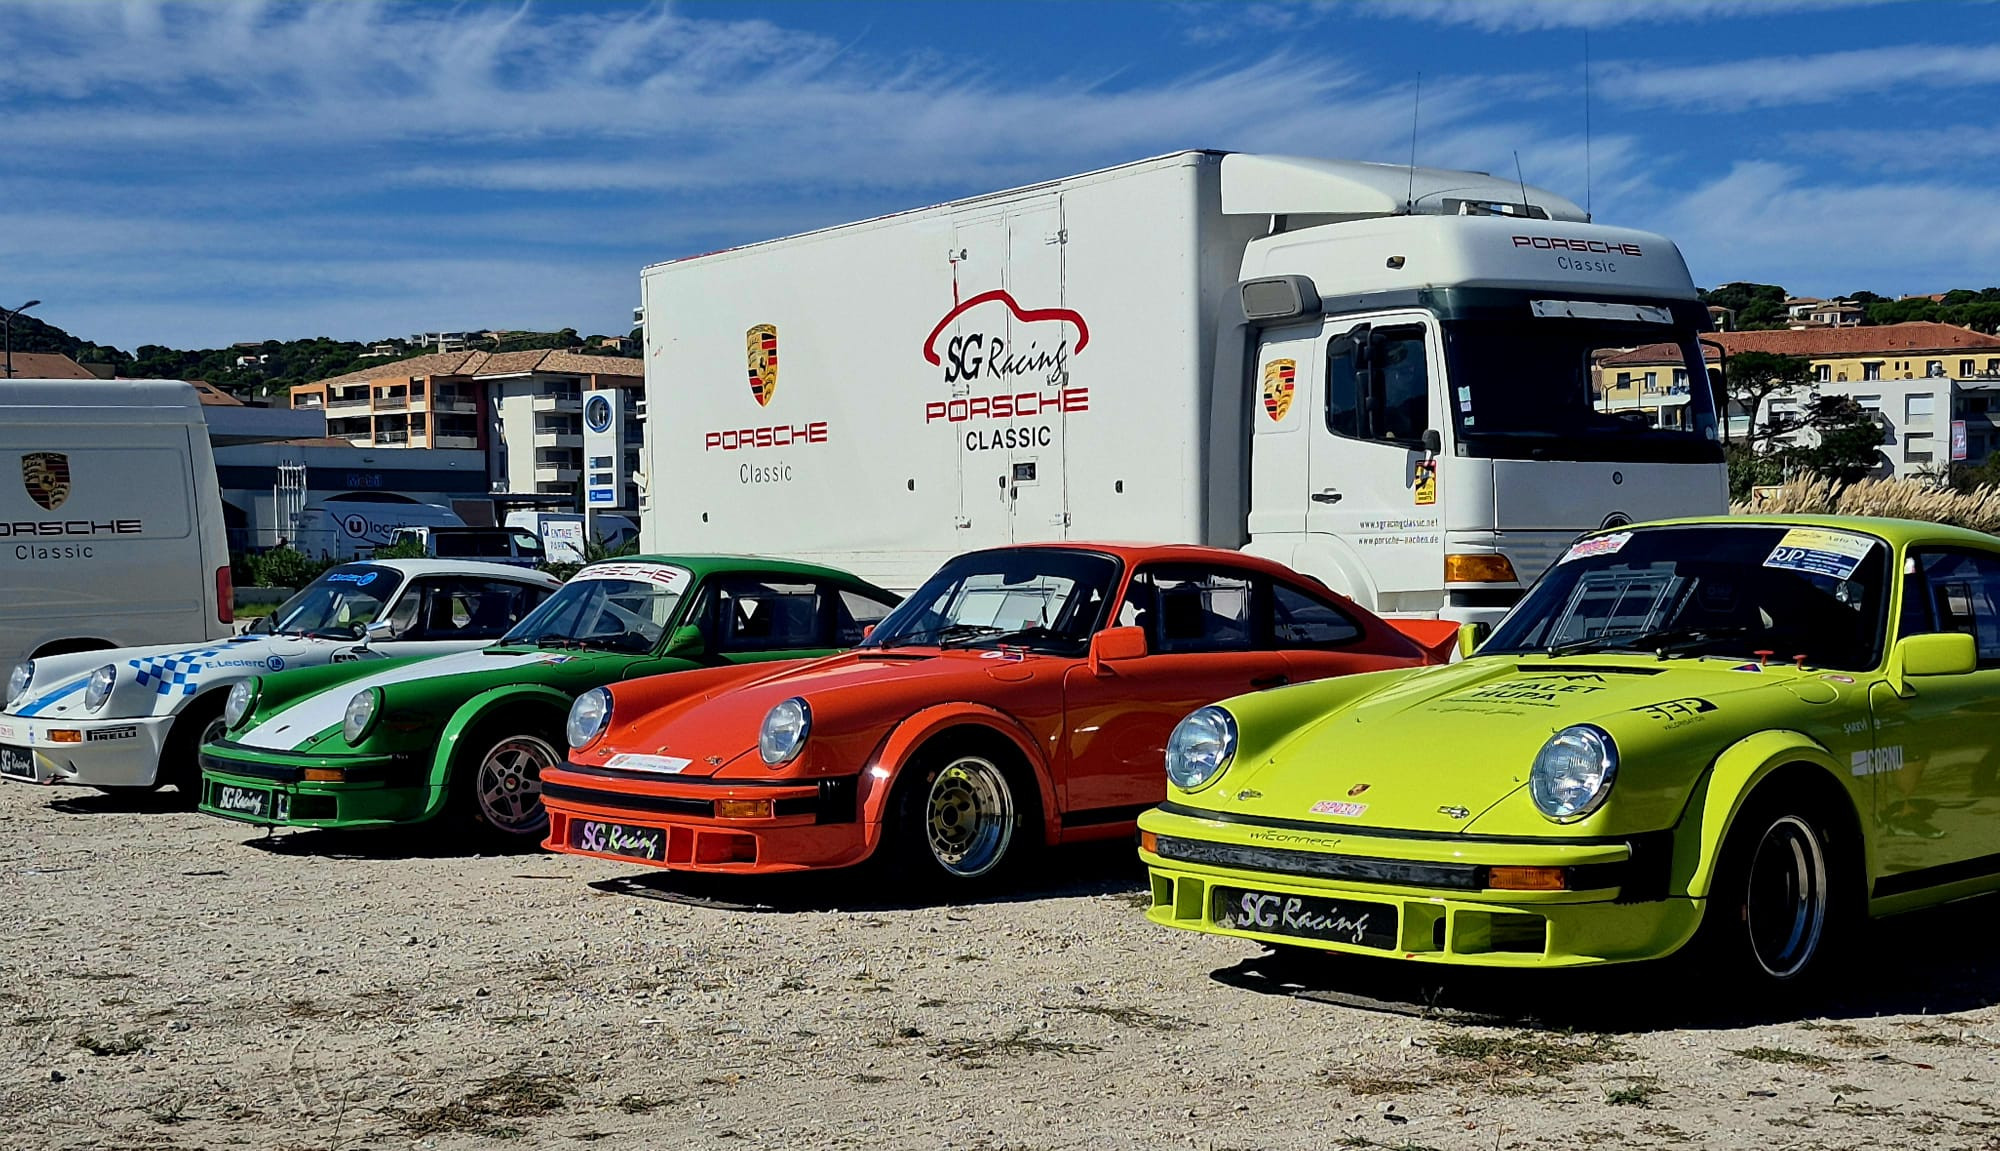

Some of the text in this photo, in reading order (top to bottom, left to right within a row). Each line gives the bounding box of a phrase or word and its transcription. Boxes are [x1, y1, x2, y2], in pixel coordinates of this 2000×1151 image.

[1512, 236, 1642, 256] PORSCHE
[1557, 257, 1616, 273] Classic
[945, 333, 1066, 384] SG Racing
[926, 388, 1088, 424] PORSCHE
[706, 422, 828, 451] PORSCHE
[966, 426, 1051, 451] CLASSIC
[740, 461, 792, 484] Classic
[15, 544, 93, 560] Classic
[206, 659, 265, 669] E.Leclerc
[86, 726, 136, 741] PIRELLI
[1, 749, 11, 772] SG
[1868, 745, 1904, 774] CORNU
[220, 786, 262, 815] SG Racing
[581, 822, 659, 860] SG Racing
[1237, 892, 1370, 944] SG Racing
